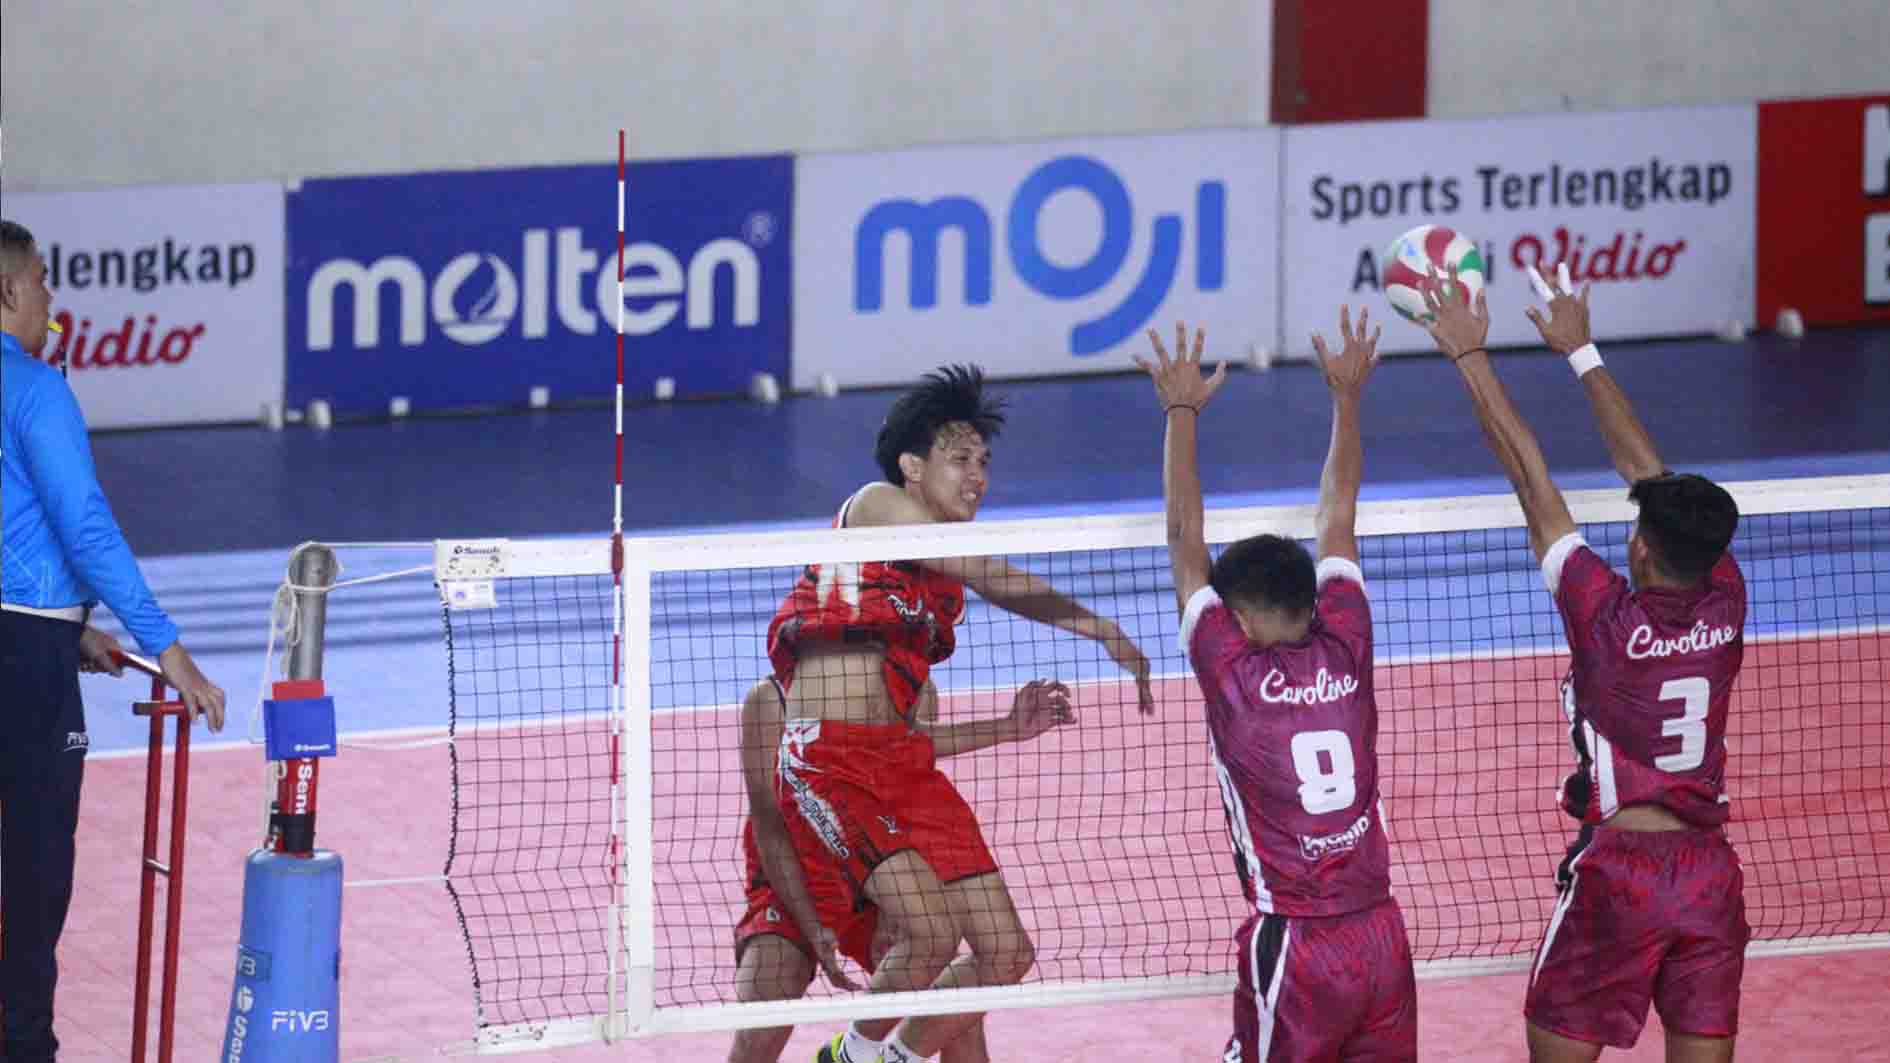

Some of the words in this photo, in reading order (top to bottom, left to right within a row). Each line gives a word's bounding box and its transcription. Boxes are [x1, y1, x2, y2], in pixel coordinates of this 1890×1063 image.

[1311, 177, 1460, 224] Sports
[1478, 158, 1732, 210] Terlengkap
[50, 237, 256, 293] lengkap
[1511, 226, 1687, 283] Vidio
[307, 227, 760, 351] molten
[1627, 620, 1738, 660] Caroline
[1260, 667, 1358, 704] Caroline
[1654, 676, 1711, 773] 3
[1290, 729, 1357, 815] 8
